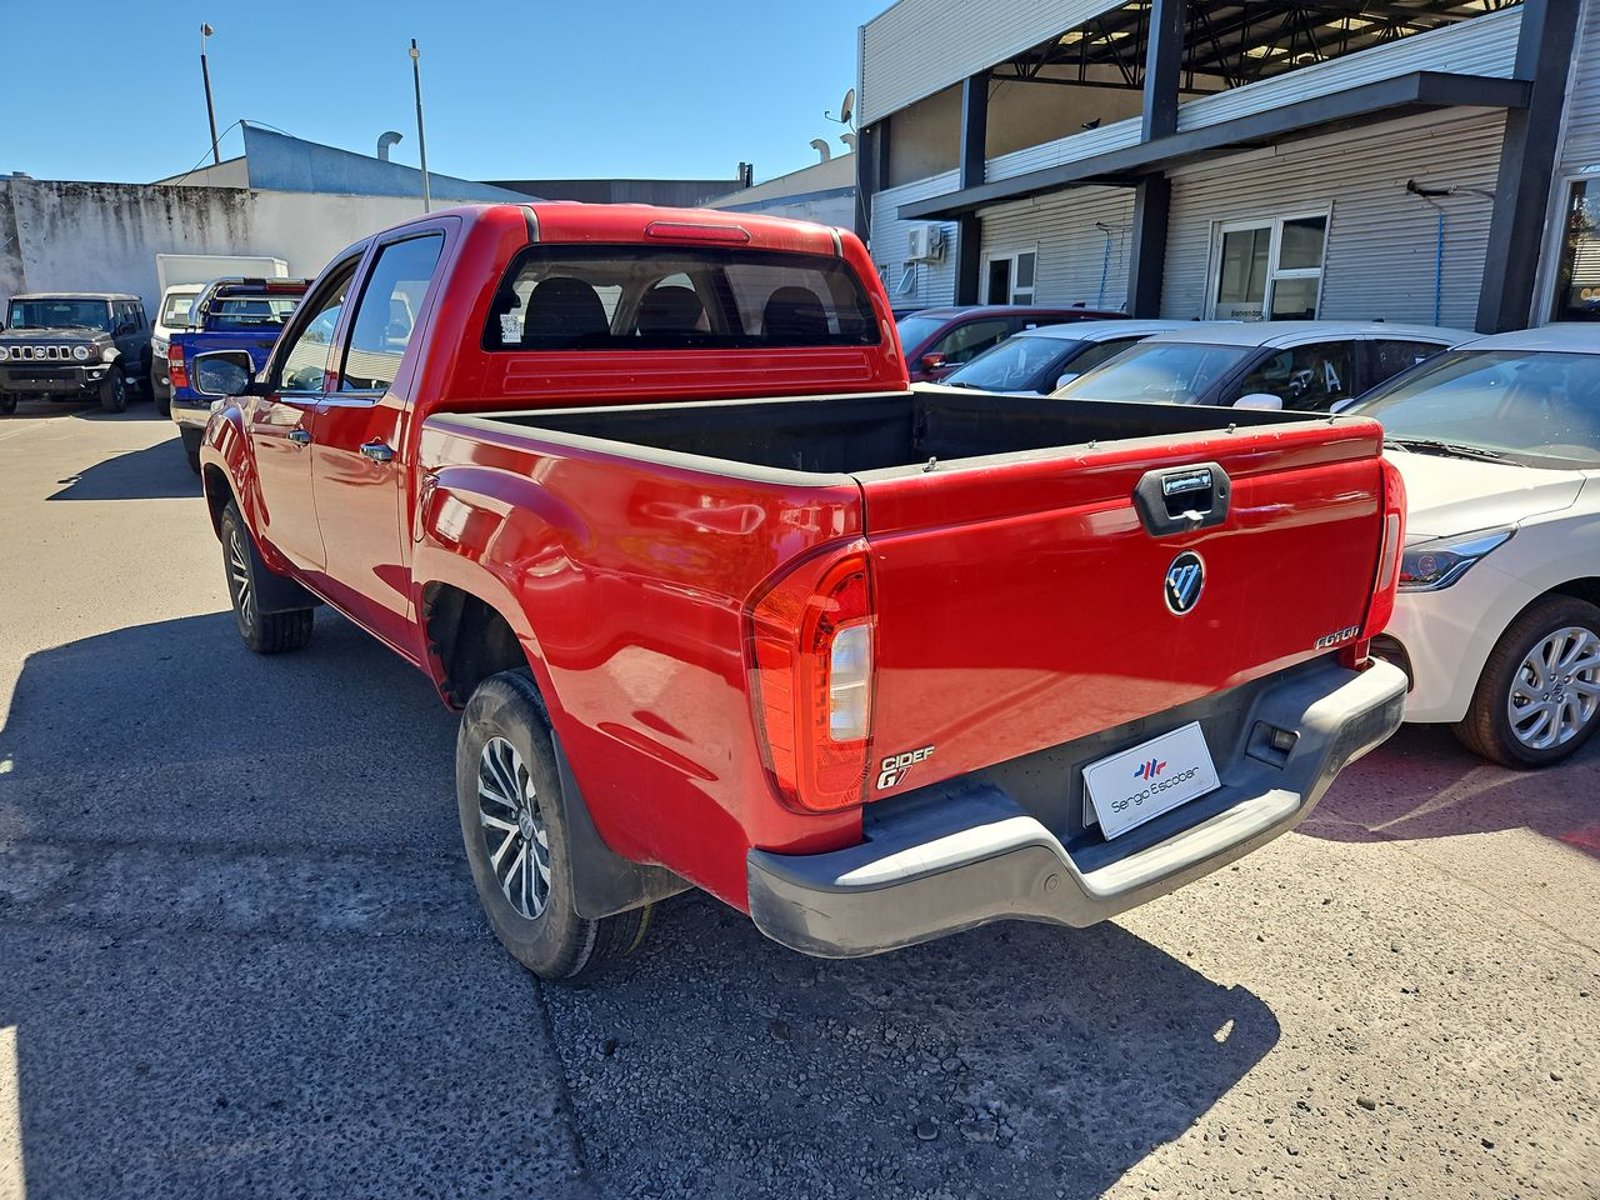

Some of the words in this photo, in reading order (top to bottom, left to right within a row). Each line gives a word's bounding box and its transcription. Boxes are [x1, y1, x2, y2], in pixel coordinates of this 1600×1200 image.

[881, 745, 935, 771] CIDEF
[877, 765, 913, 790] G7
[1150, 766, 1199, 795] Escobar
